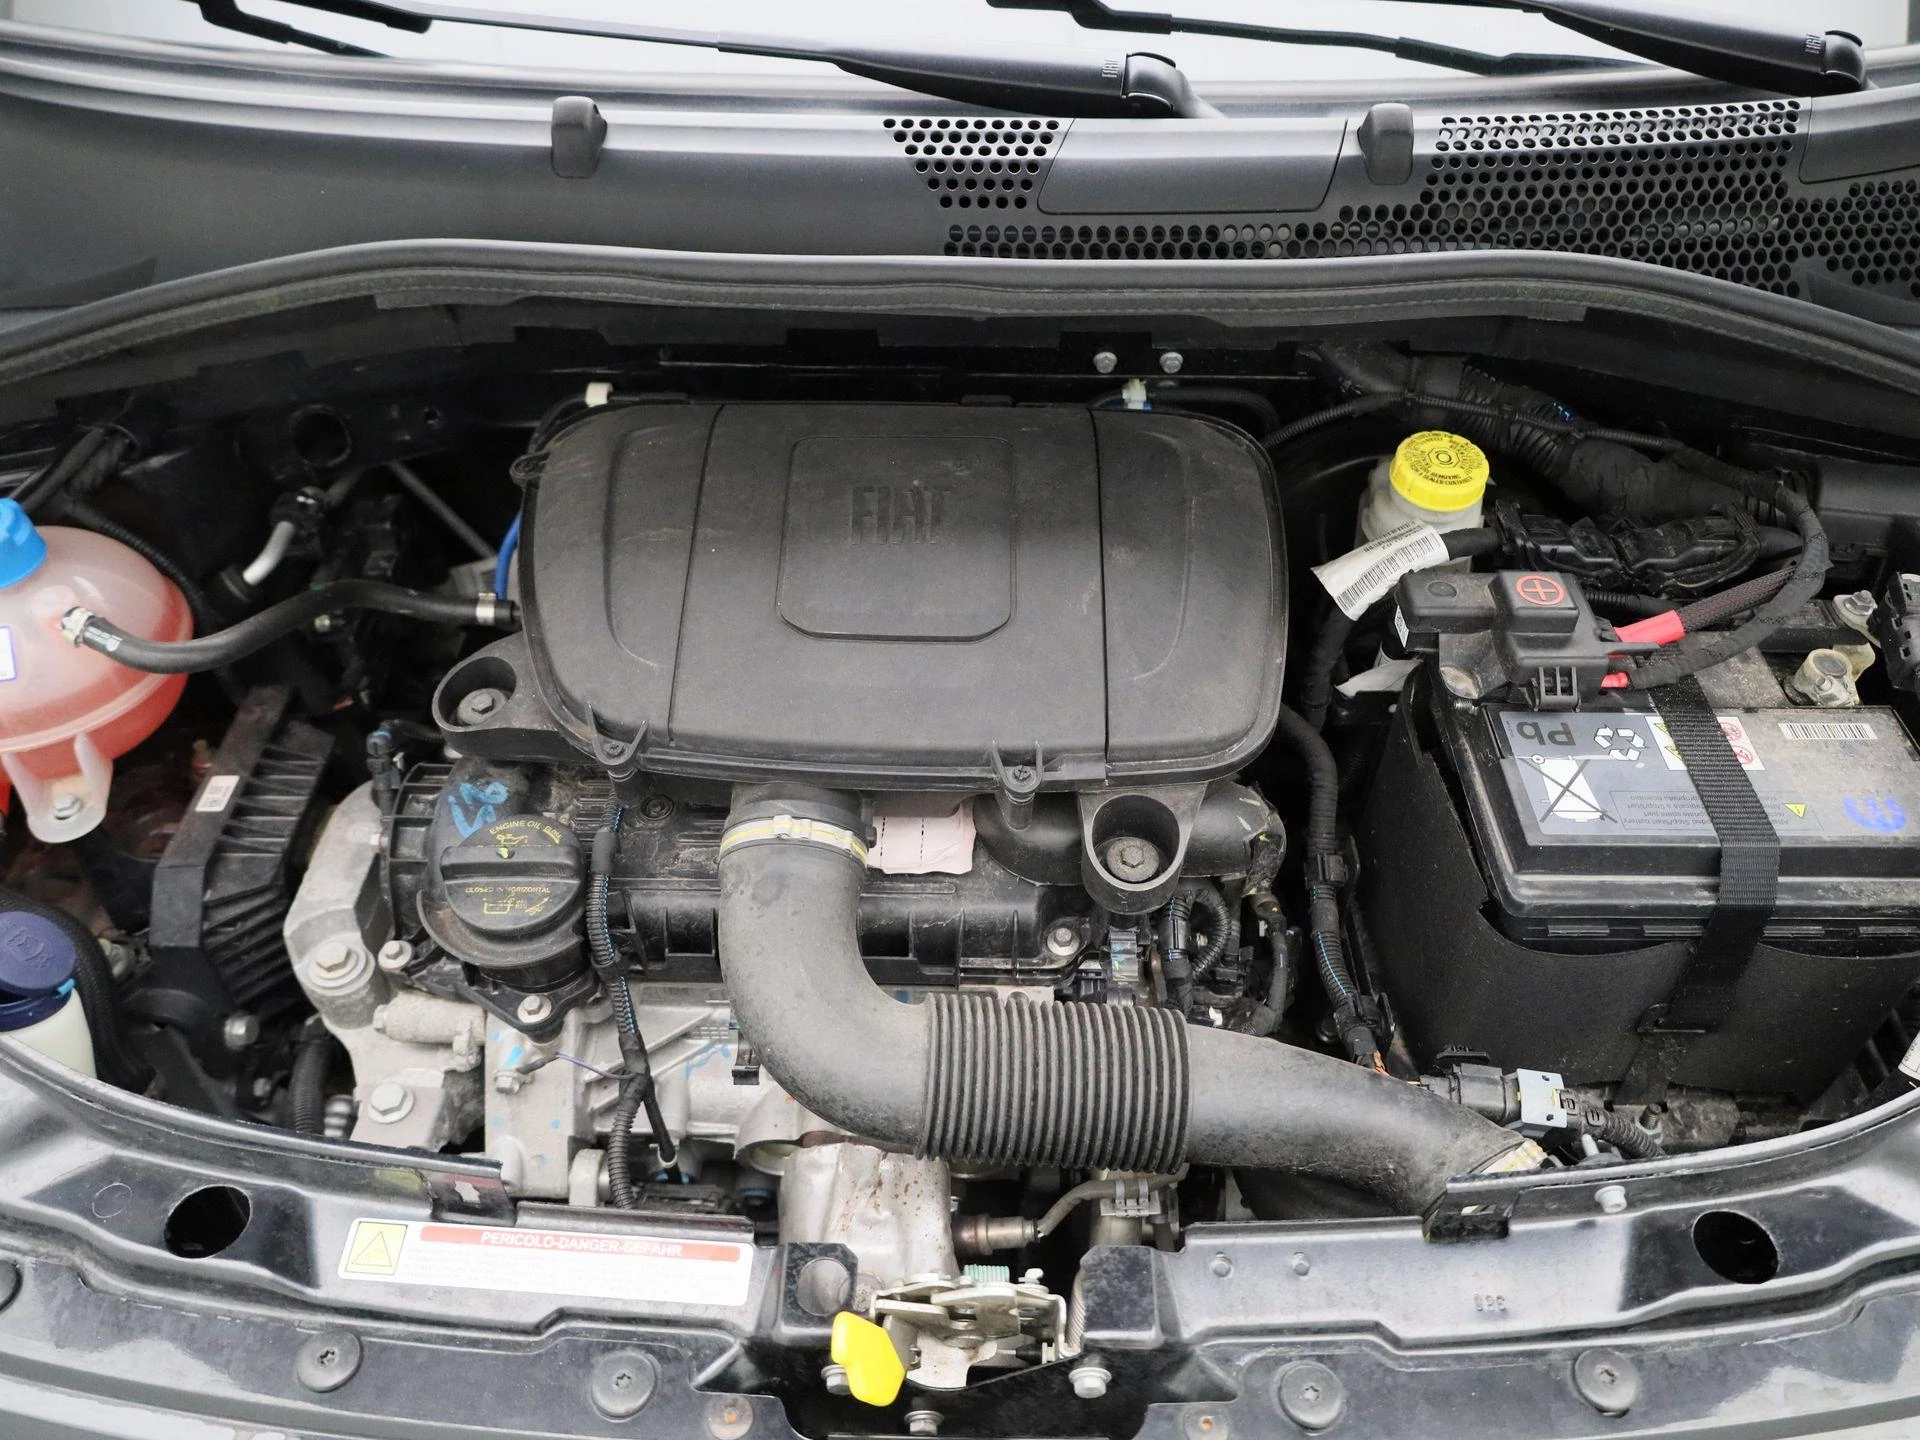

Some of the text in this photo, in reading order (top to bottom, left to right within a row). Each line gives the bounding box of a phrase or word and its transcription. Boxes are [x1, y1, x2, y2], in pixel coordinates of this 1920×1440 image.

[850, 485, 952, 545] FIAT
[1516, 721, 1576, 746] Pb
[489, 819, 526, 835] ENGINE
[527, 820, 541, 830] OIL
